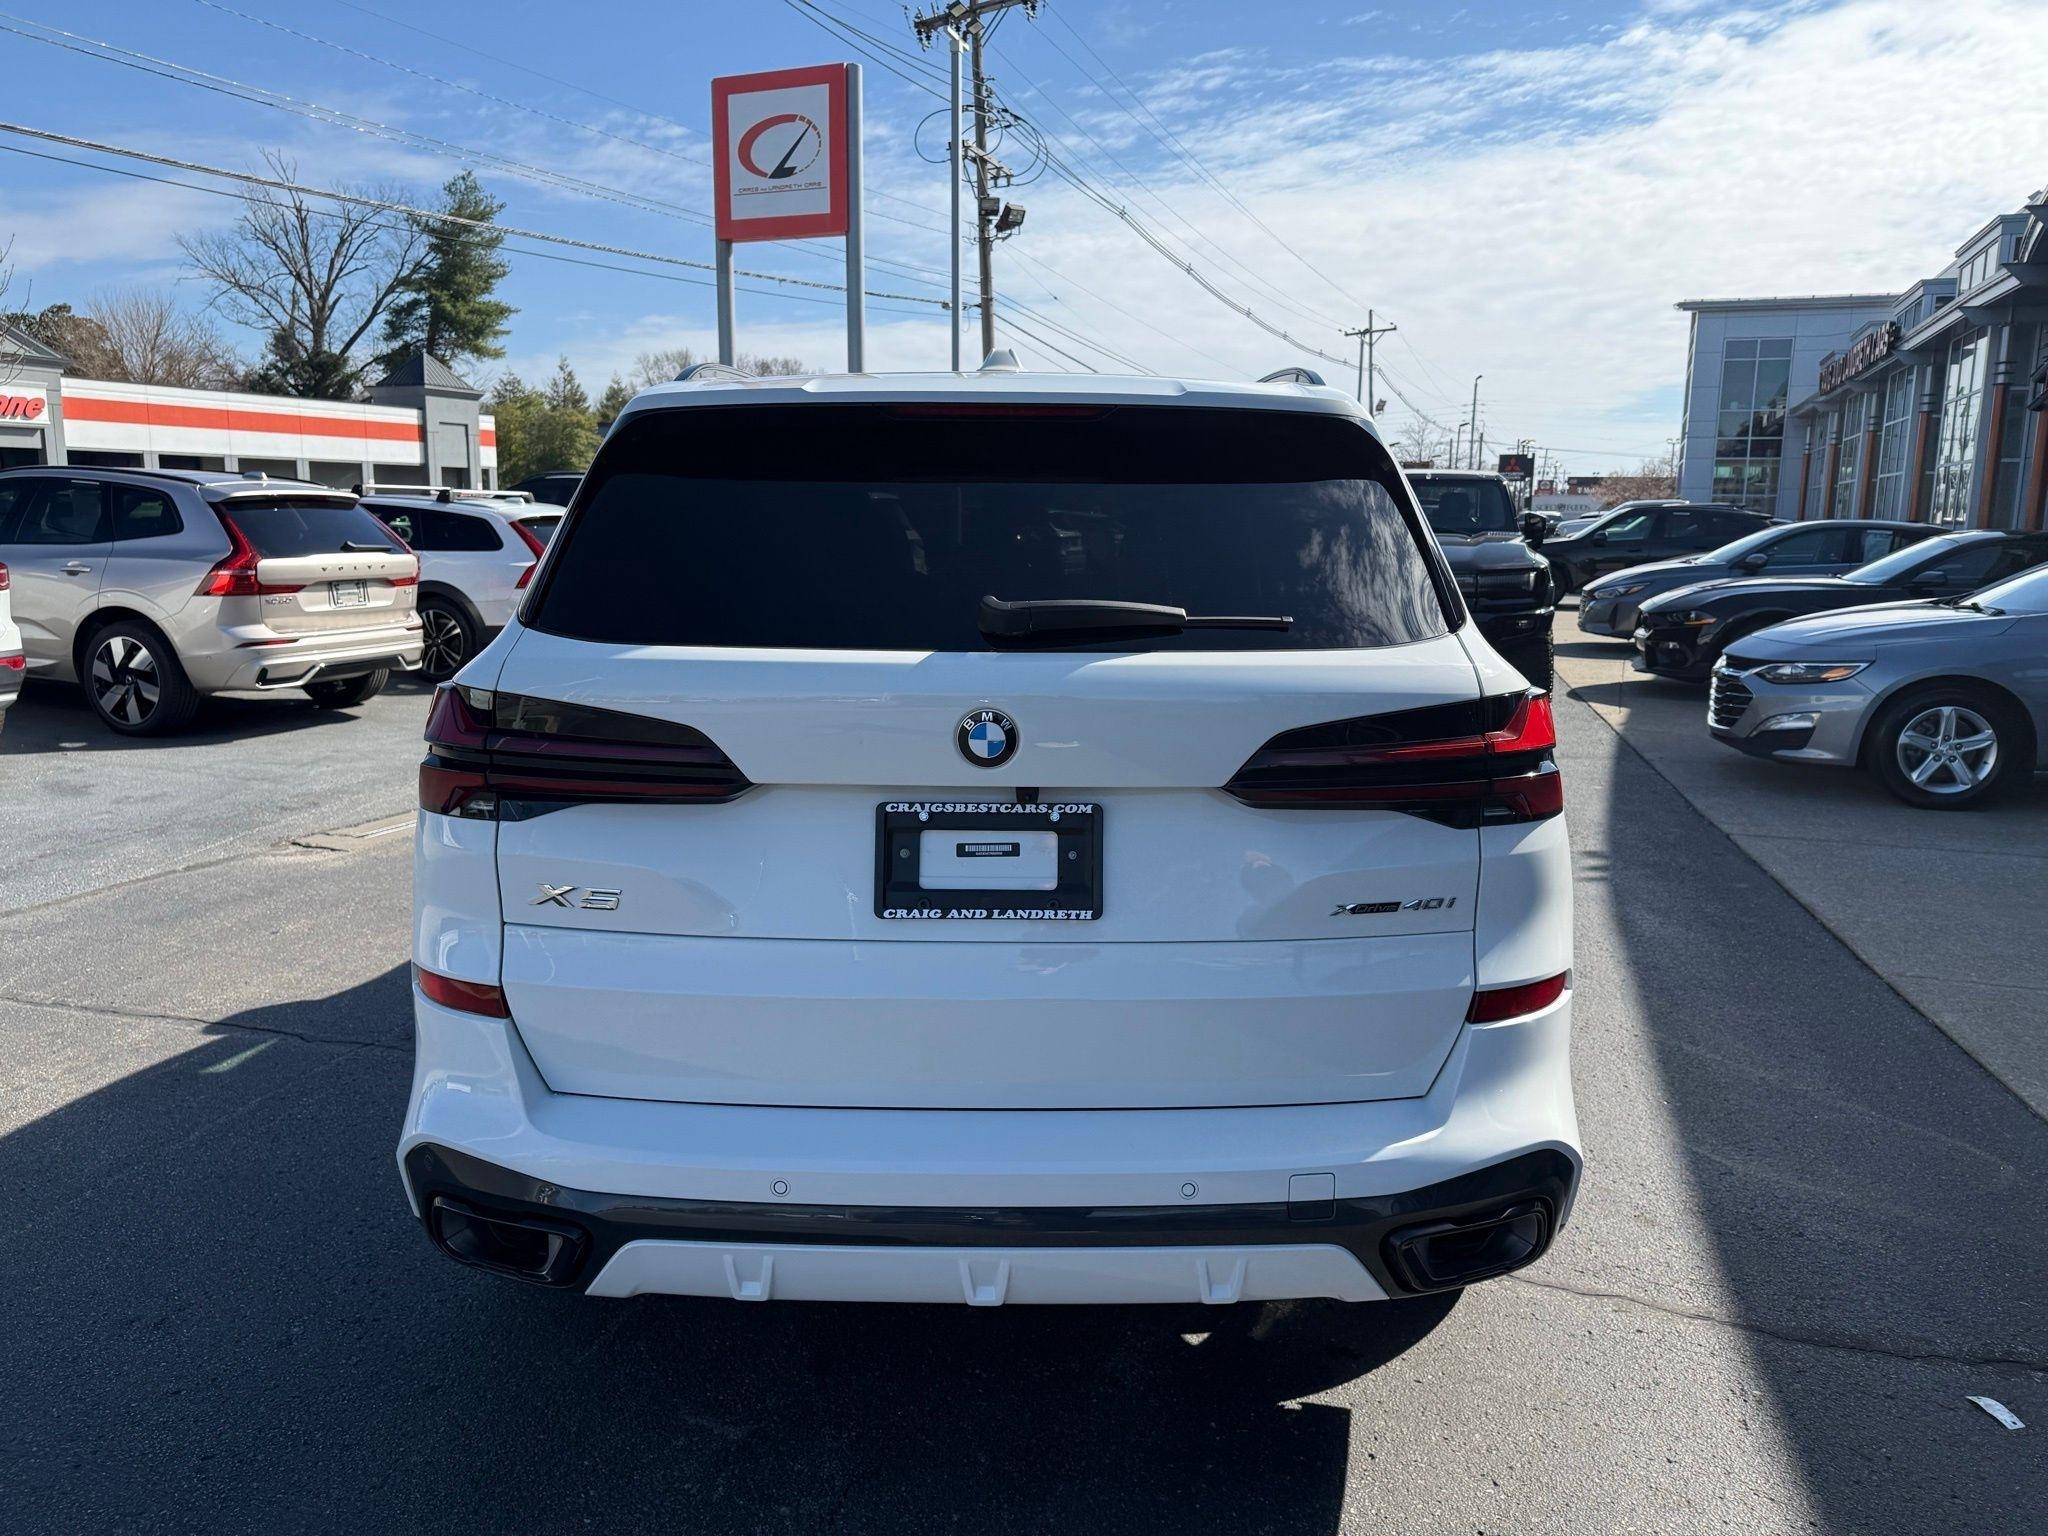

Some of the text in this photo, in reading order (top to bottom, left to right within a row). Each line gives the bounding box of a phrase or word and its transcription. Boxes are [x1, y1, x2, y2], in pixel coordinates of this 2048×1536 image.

[321, 564, 386, 572] VOLVO
[963, 711, 1012, 731] BMW
[885, 803, 1094, 814] CRAIGSBESTCARS.COM
[527, 883, 622, 911] X5
[883, 908, 1094, 920] CRAIG AND LANDRETH
